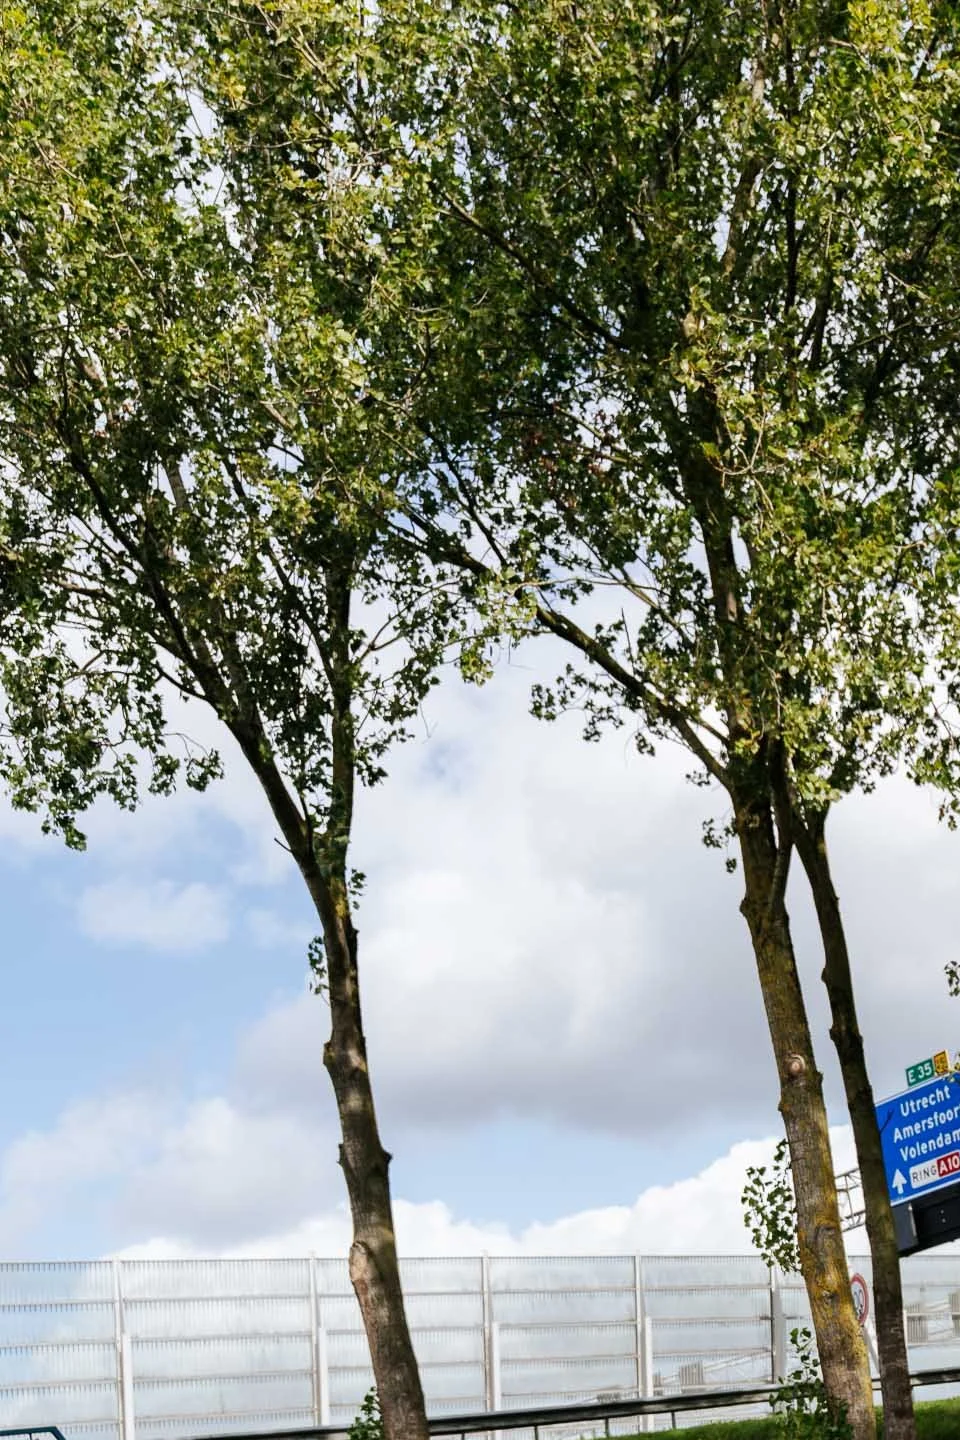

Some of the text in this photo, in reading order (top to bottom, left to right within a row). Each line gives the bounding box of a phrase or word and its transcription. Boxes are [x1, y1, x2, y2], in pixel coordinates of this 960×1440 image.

[907, 1063, 932, 1083] E 35
[900, 1085, 951, 1117] Utrecht
[912, 1155, 960, 1182] RING A10
